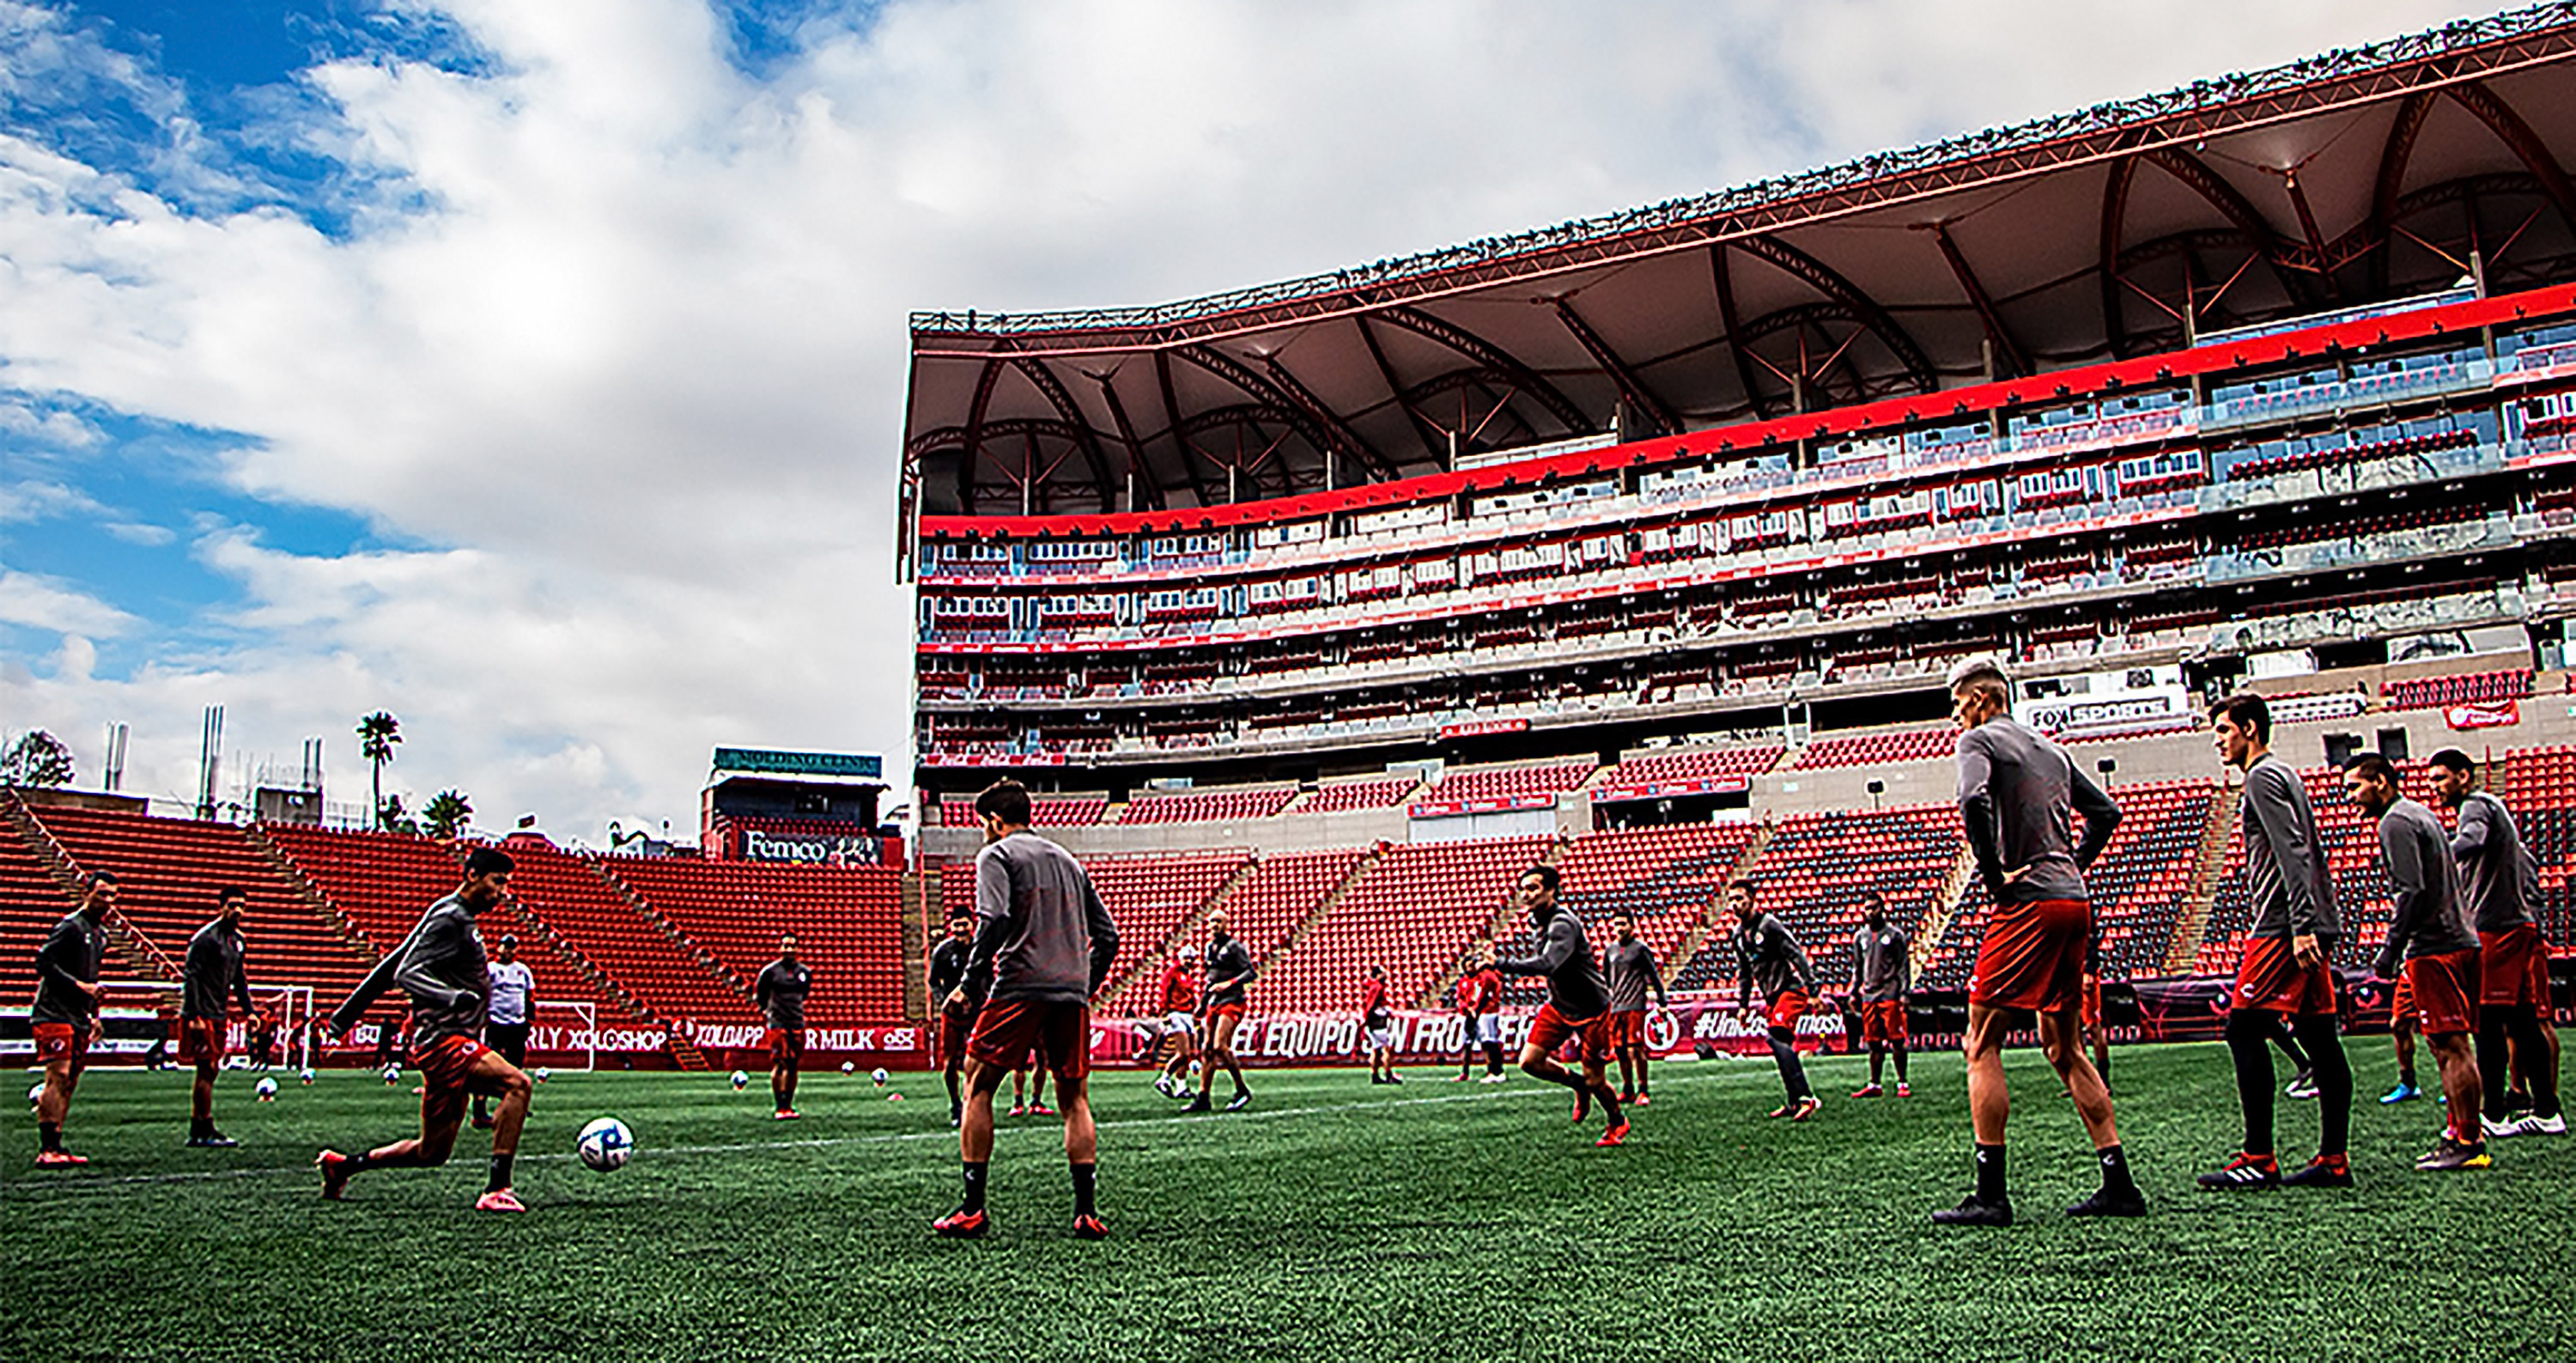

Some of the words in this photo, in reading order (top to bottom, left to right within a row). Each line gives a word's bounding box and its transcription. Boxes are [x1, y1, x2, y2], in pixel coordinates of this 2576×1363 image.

[2032, 707, 2069, 728] FOX
[2071, 698, 2166, 725] SPORTS
[744, 831, 825, 861] Femco
[567, 1029, 667, 1051] XOLOSHOP
[693, 1025, 765, 1048] XOLOAPP
[1230, 1019, 1257, 1056] EL
[1262, 1019, 1358, 1058] EQUIPO
[1361, 1017, 1409, 1053] SN
